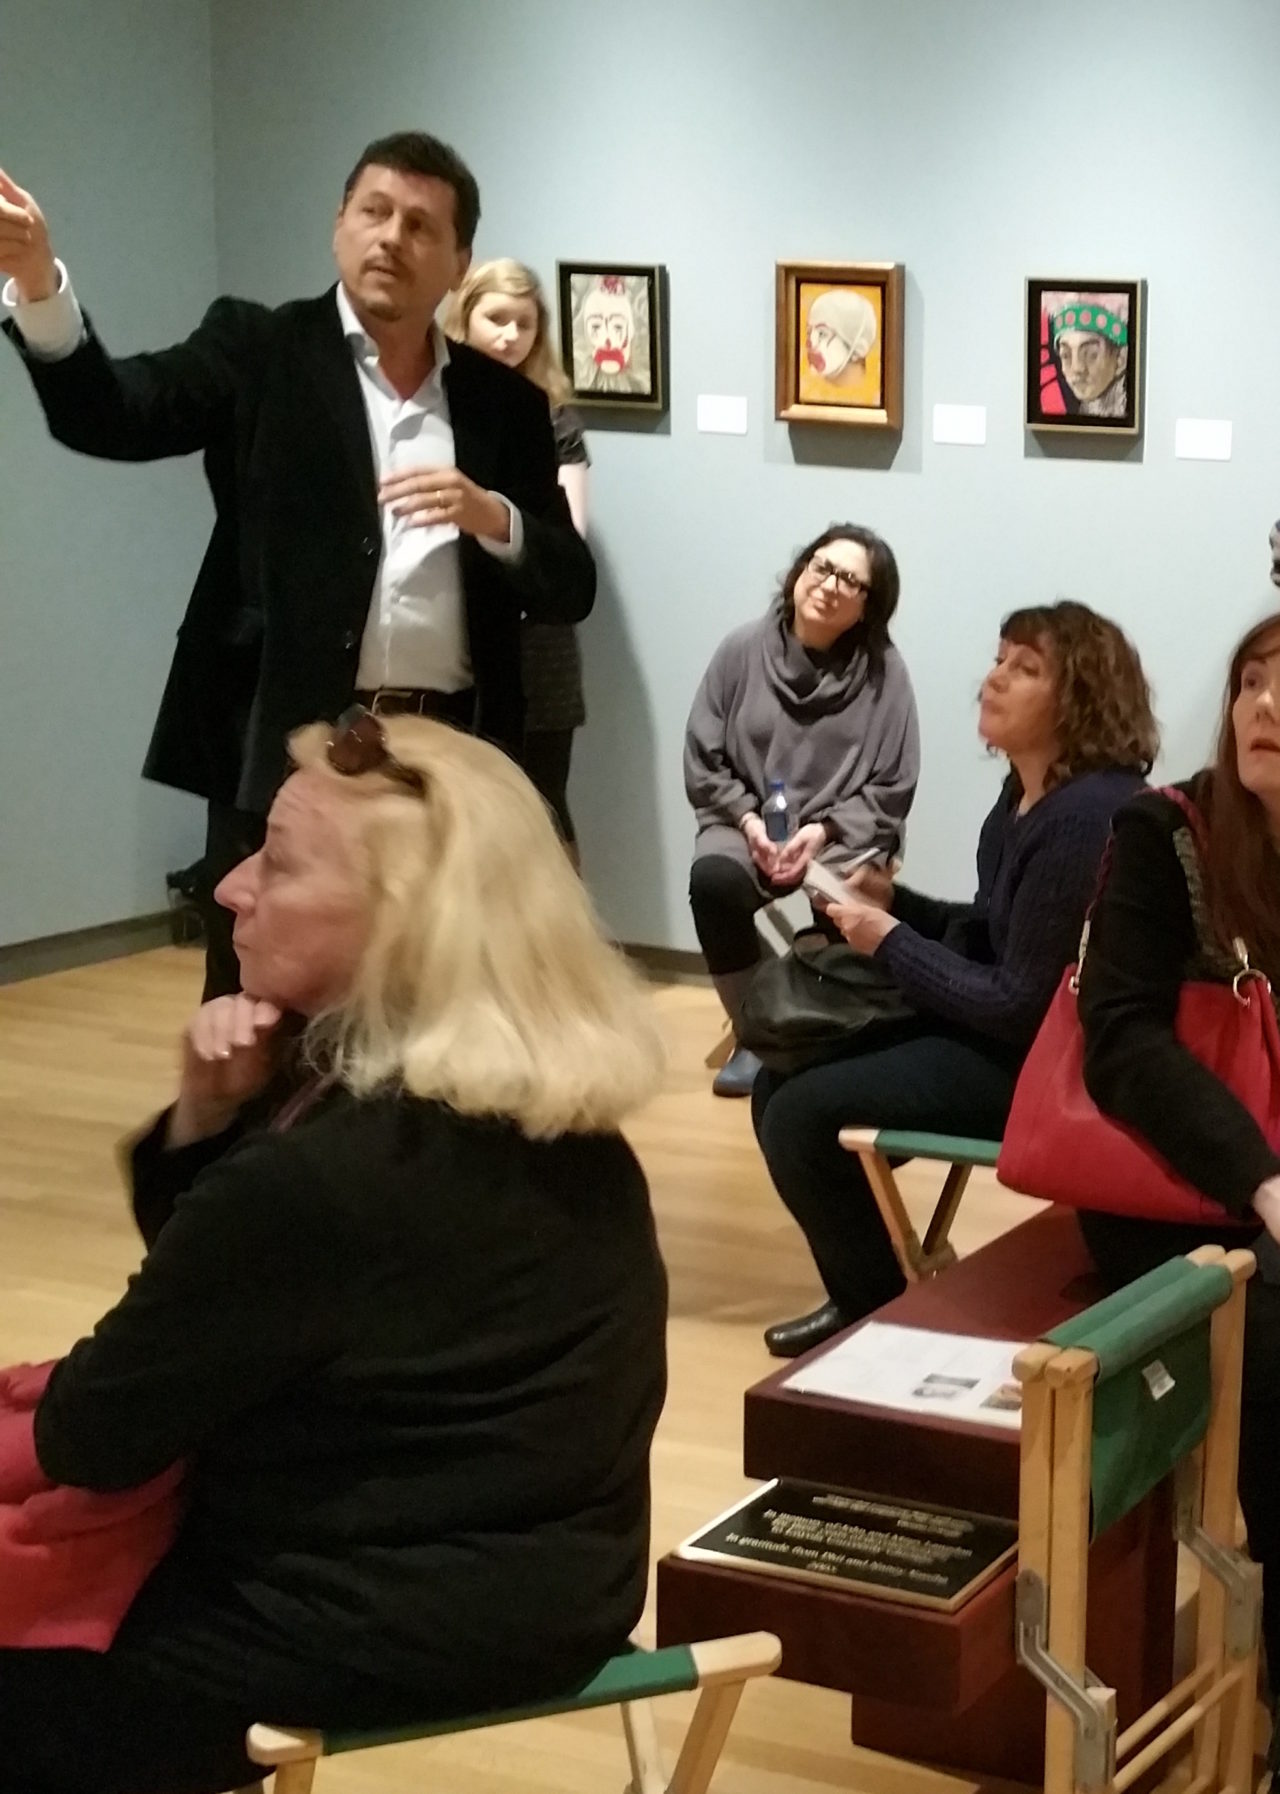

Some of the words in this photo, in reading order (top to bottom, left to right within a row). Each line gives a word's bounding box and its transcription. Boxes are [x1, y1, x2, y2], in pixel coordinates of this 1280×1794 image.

[725, 1532, 739, 1543] In
[738, 1535, 790, 1553] gratitude
[791, 1545, 820, 1558] from
[845, 1557, 869, 1568] and
